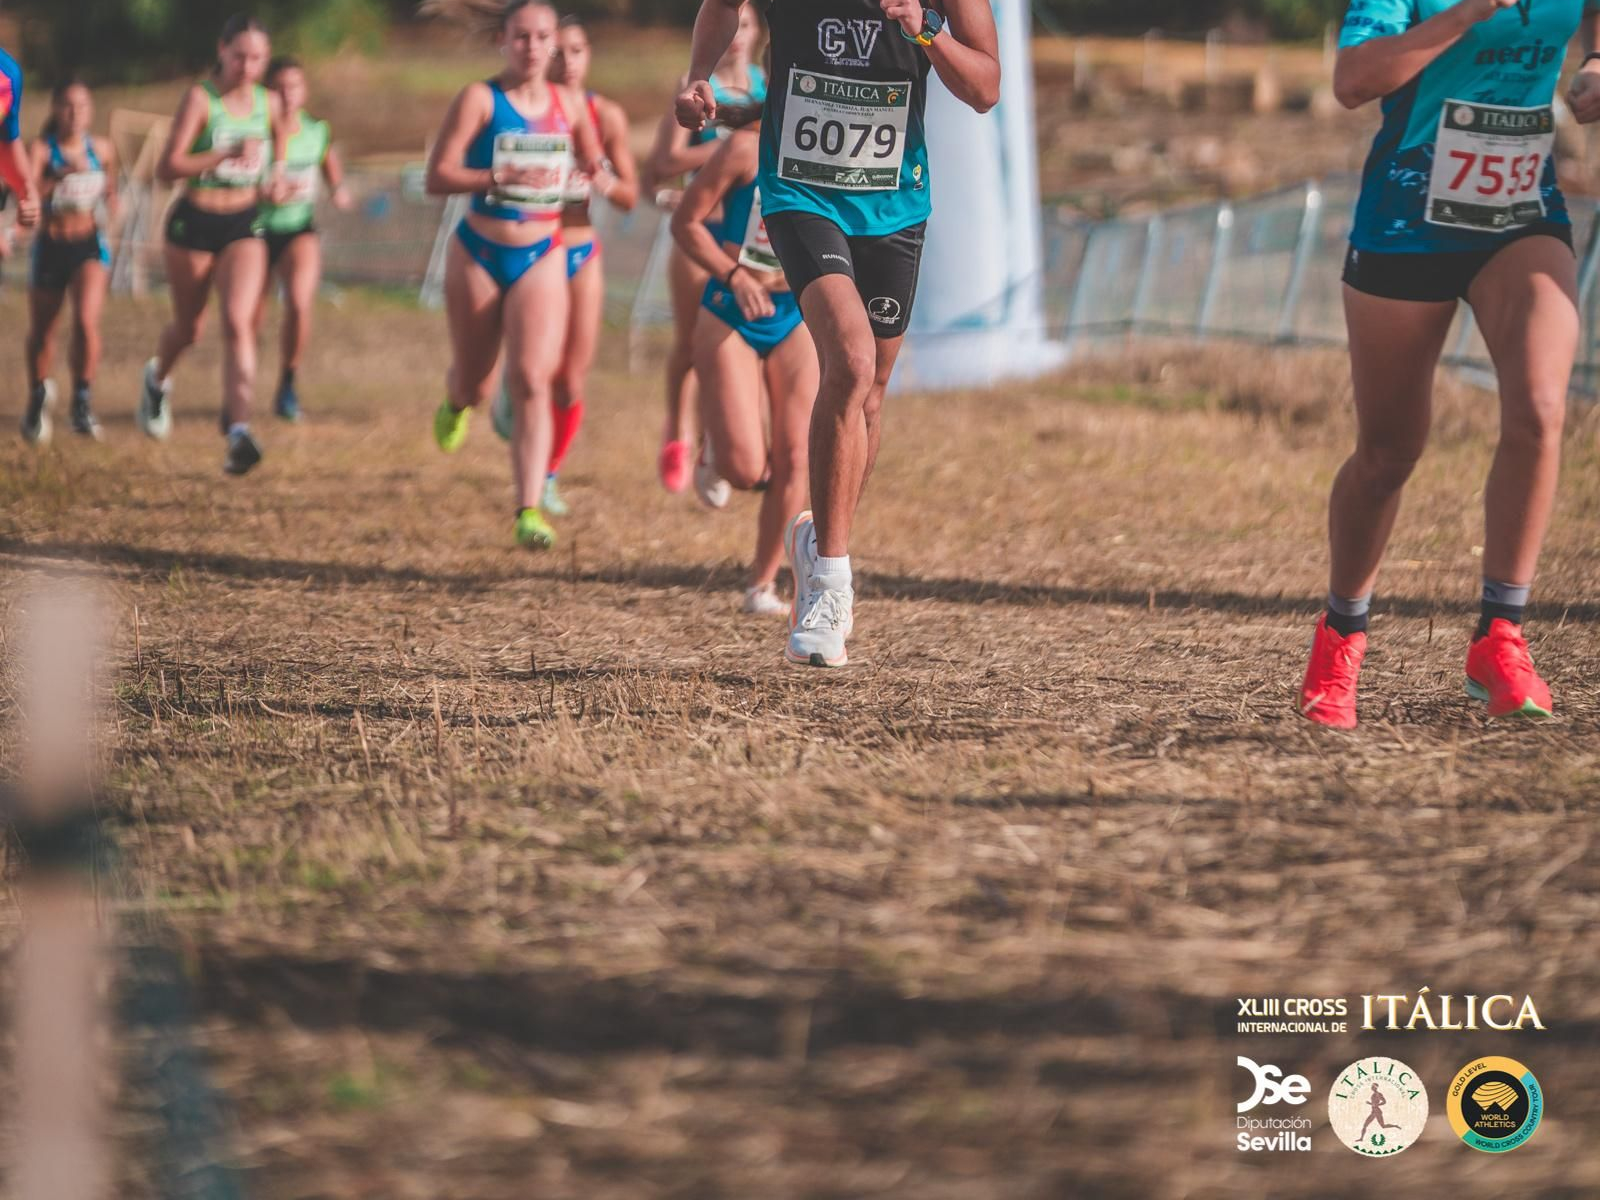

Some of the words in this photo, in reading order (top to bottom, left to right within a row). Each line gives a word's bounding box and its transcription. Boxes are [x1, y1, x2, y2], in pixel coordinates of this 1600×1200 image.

[817, 18, 882, 60] CV
[823, 81, 880, 100] ITÁLICA
[794, 115, 897, 159] 6079
